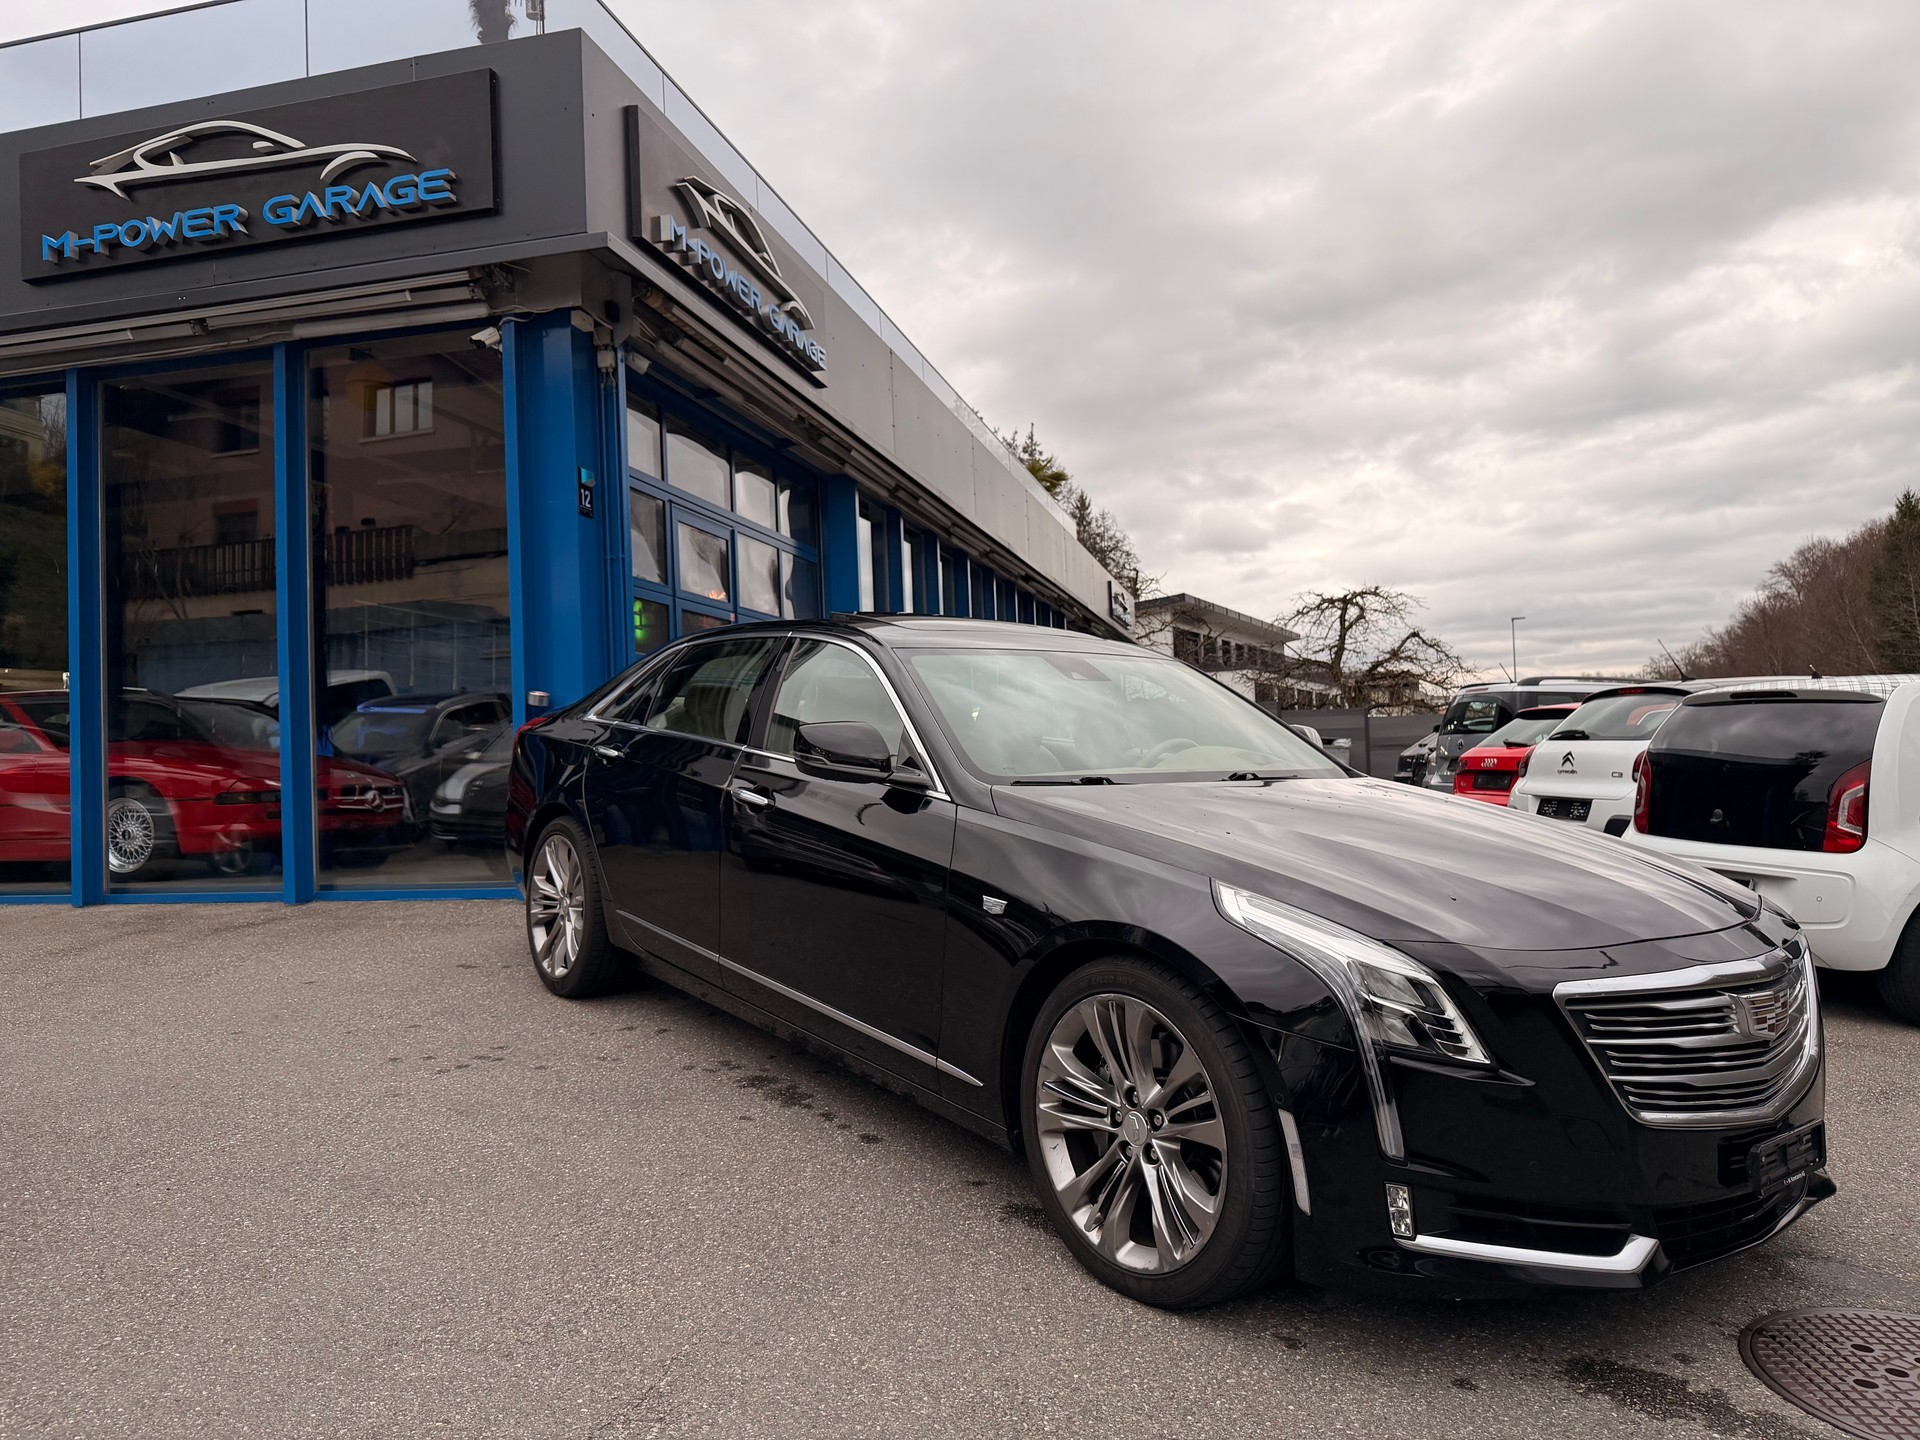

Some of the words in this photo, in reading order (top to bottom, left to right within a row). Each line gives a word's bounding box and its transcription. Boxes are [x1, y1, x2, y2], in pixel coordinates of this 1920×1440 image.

[42, 203, 246, 262] M-POWER
[263, 167, 456, 227] GARAGE
[665, 214, 762, 312] M-POWER
[766, 303, 828, 371] GARAGE
[581, 489, 592, 508] 12
